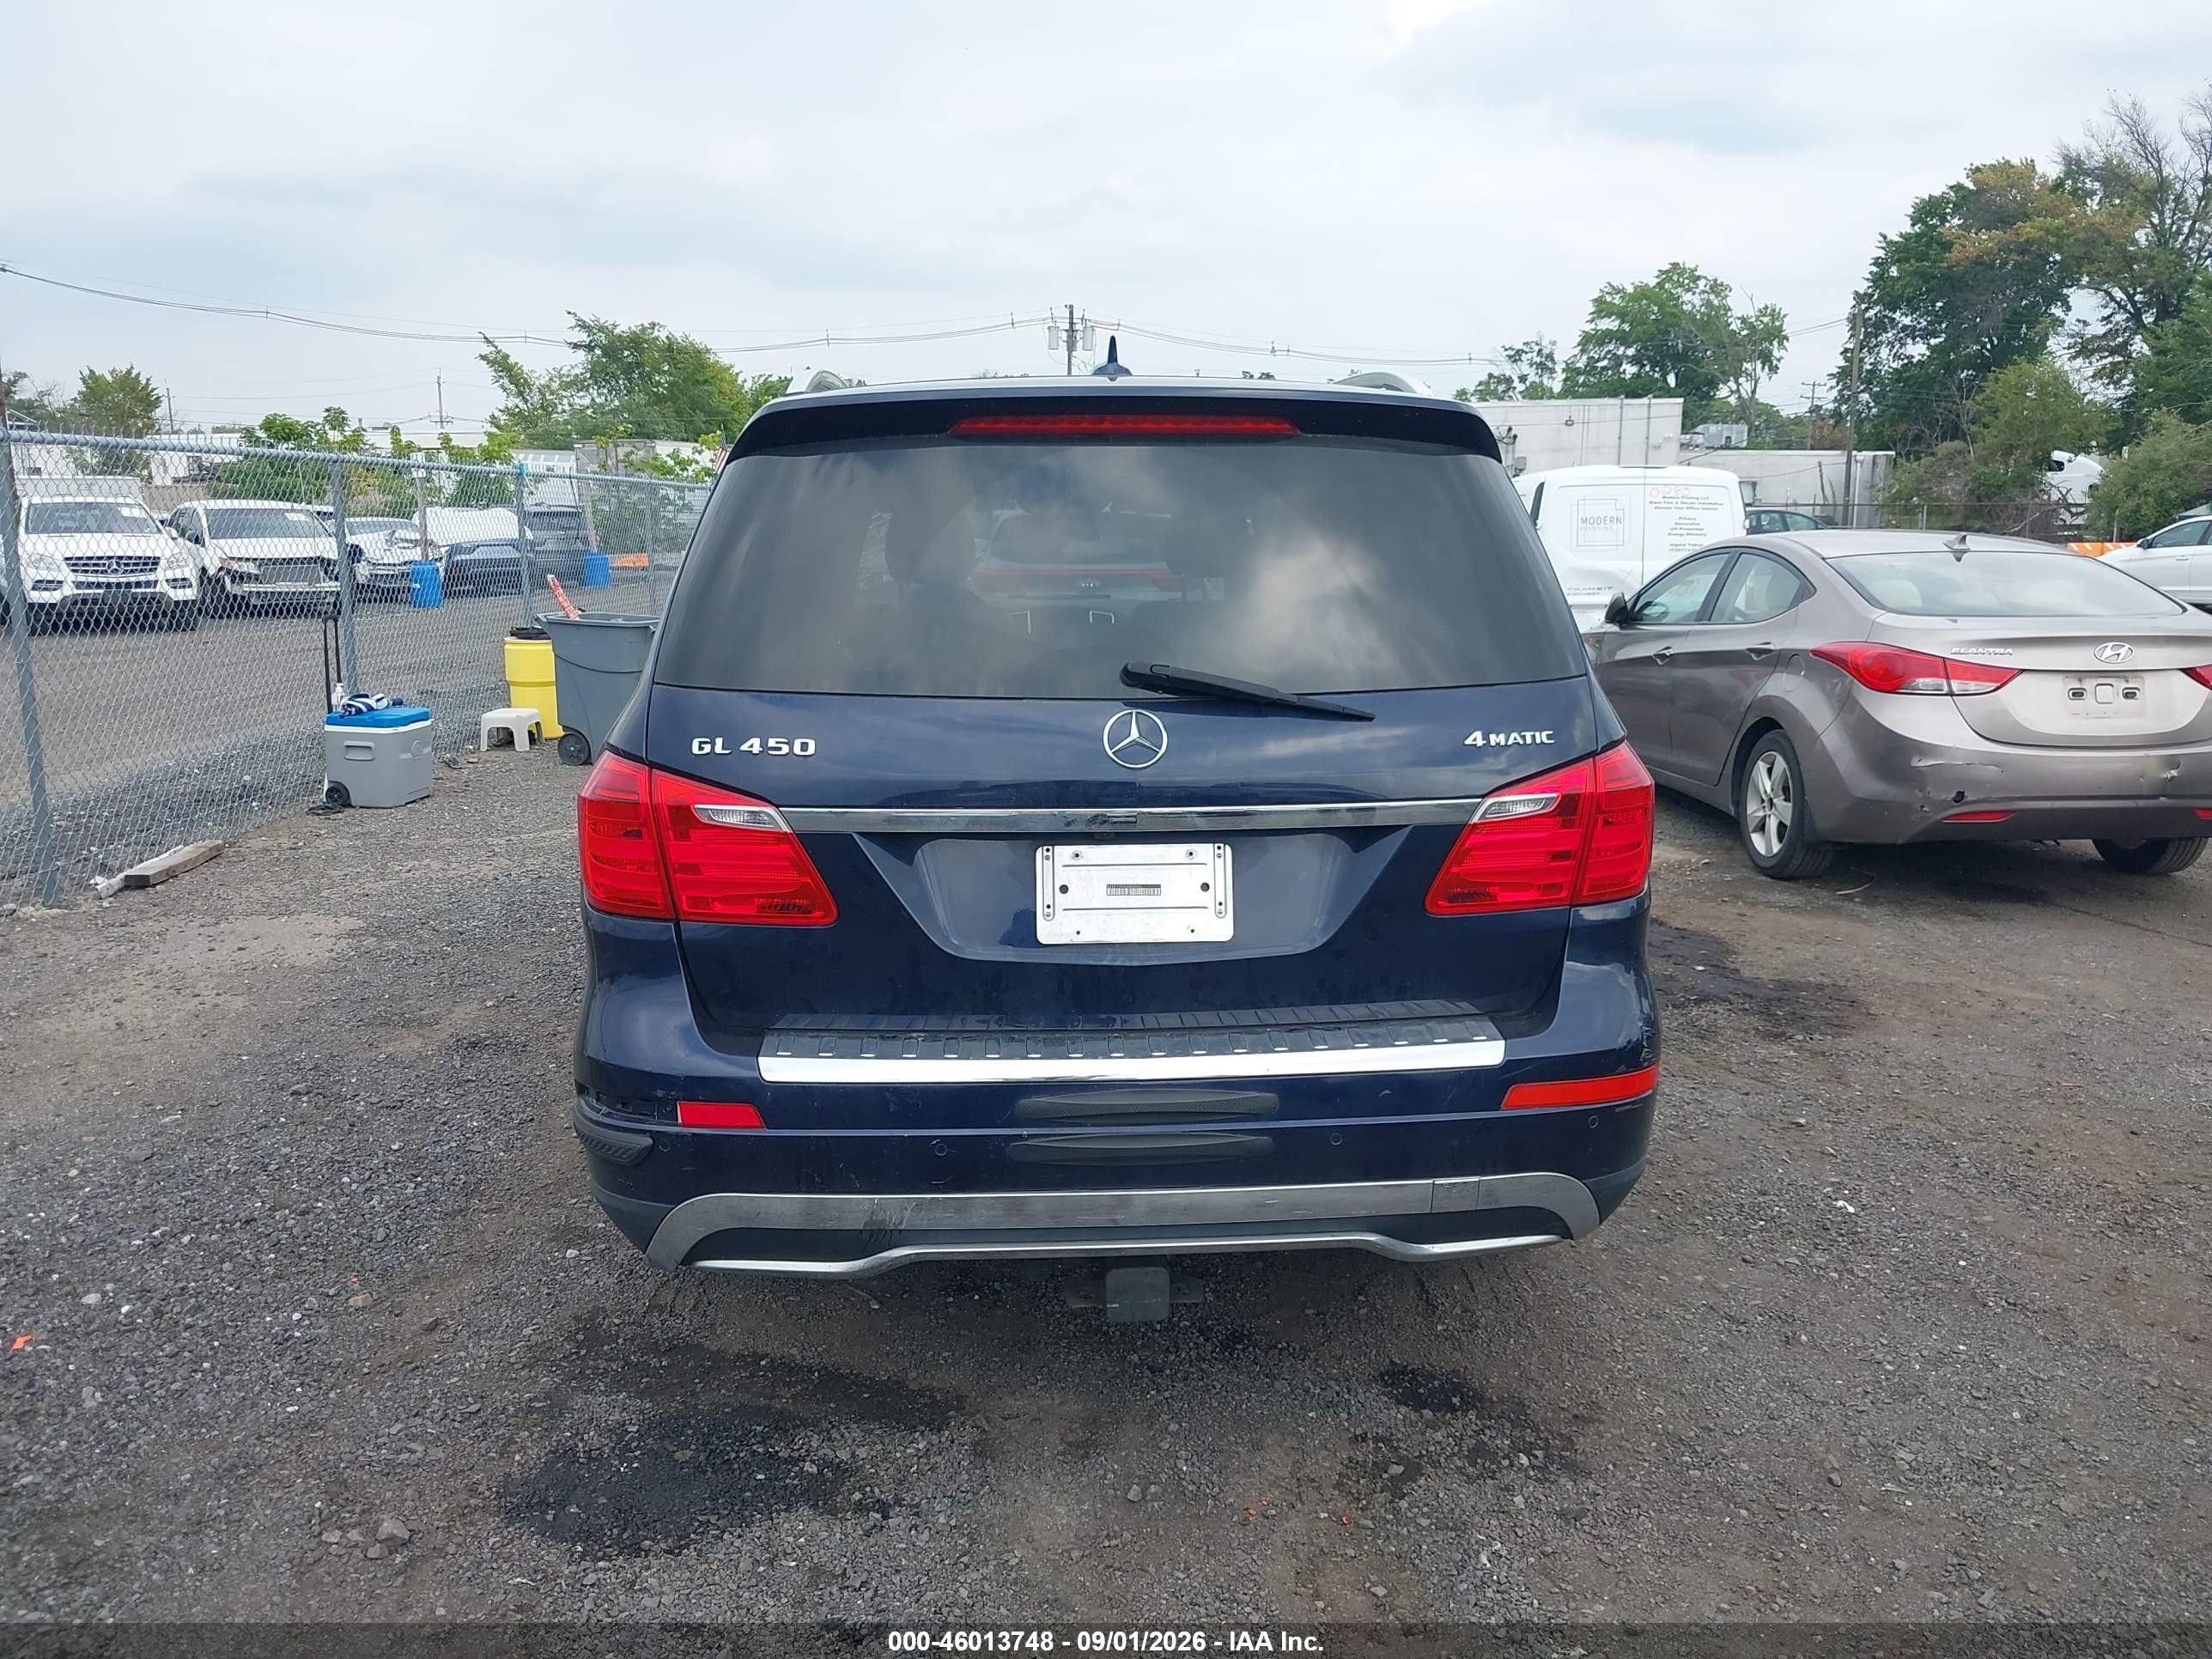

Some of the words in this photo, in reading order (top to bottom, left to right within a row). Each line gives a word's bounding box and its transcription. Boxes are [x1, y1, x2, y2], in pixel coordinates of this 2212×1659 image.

[1580, 515, 1622, 525] MODERN
[691, 737, 732, 755] GL
[739, 737, 816, 756] 450
[1463, 730, 1555, 747] 4MATIC
